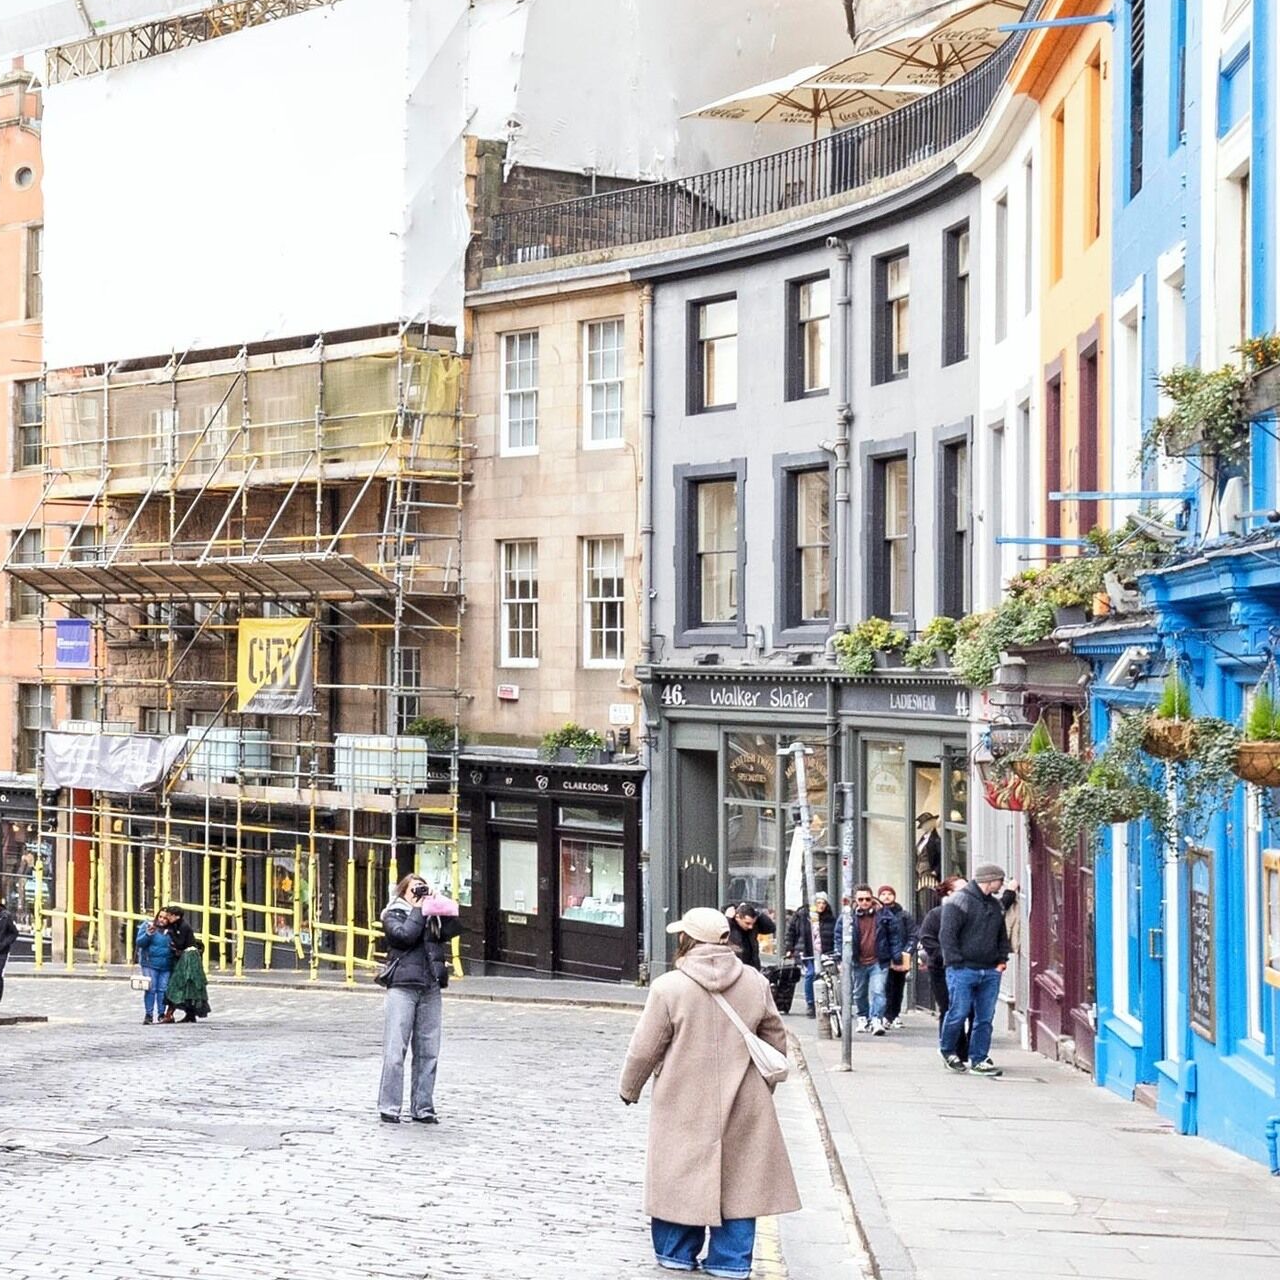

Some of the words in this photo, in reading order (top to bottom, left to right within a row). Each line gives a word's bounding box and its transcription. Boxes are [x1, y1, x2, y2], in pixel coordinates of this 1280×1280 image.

[248, 637, 299, 686] CITY
[710, 685, 761, 707] Walker
[770, 686, 814, 708] Slater
[890, 693, 937, 711] LADIESWEAR
[562, 780, 609, 793] CLARKSONS
